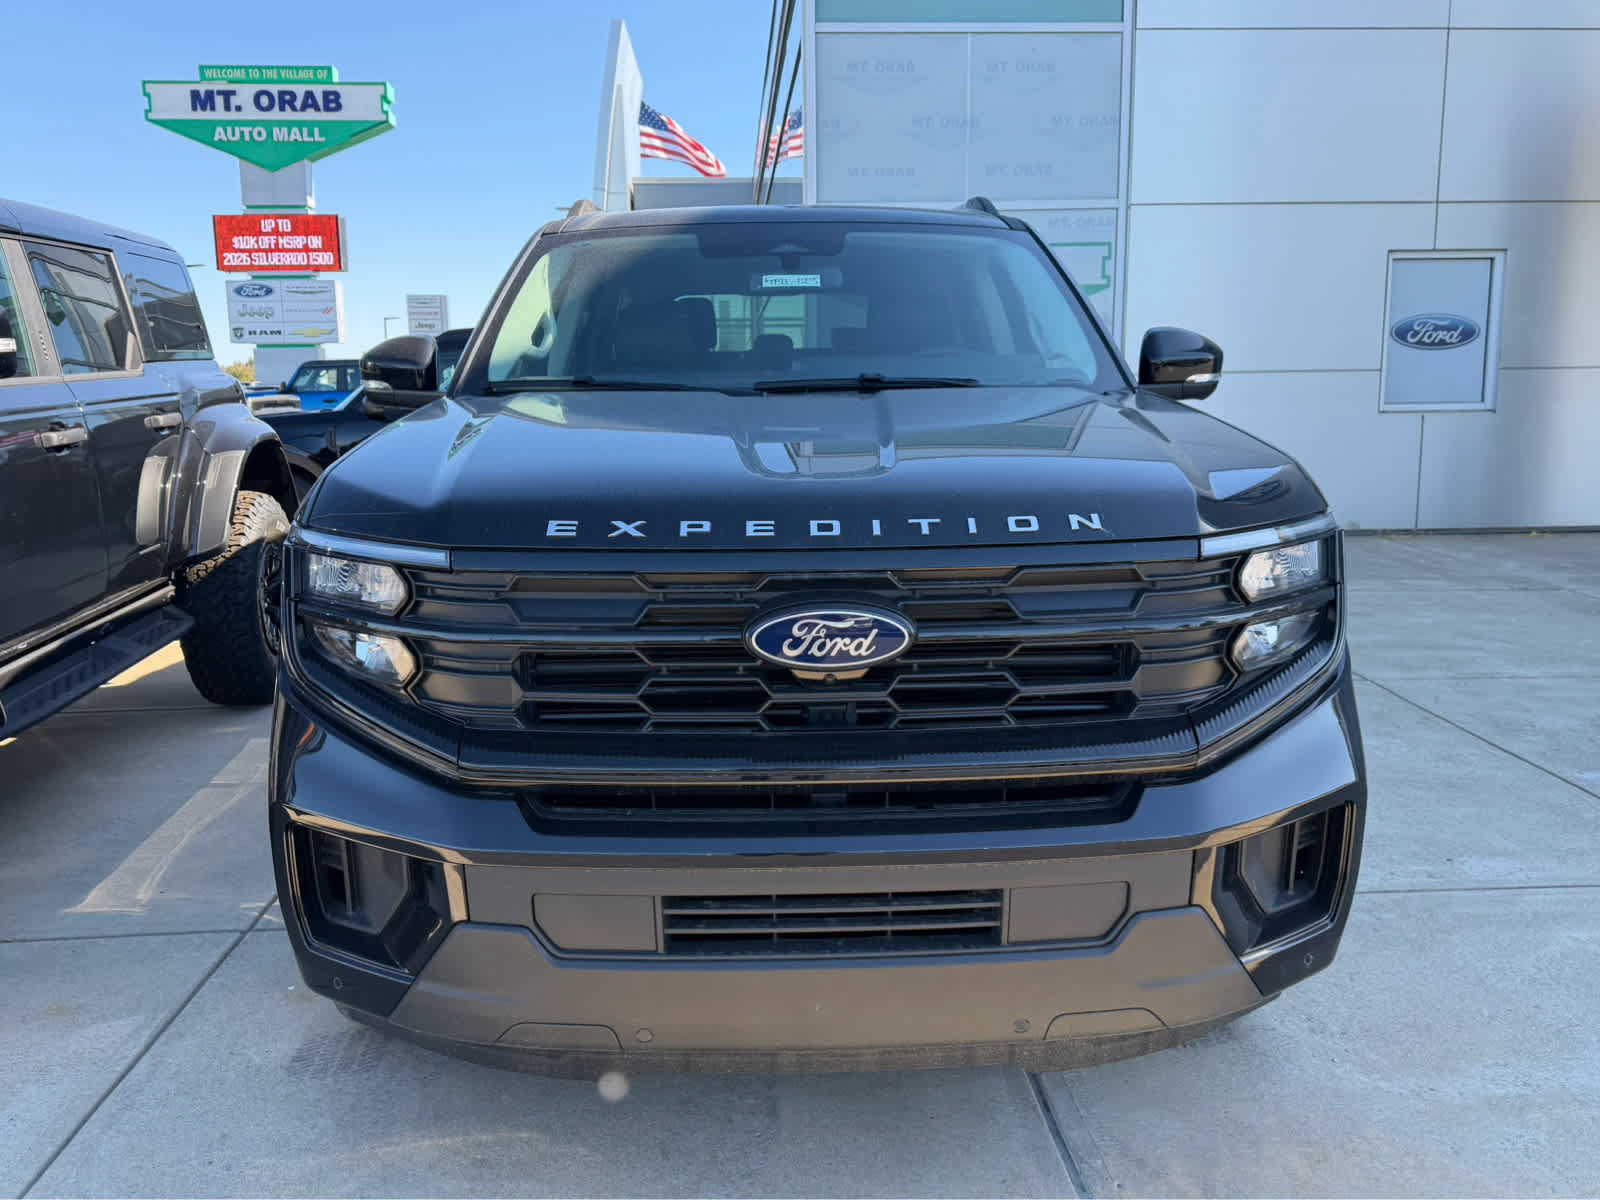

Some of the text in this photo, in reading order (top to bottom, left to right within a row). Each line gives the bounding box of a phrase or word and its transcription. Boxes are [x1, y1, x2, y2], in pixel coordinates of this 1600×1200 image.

[204, 68, 328, 80] WELCOME TO THE VILLAGE OF
[190, 89, 343, 112] MT. ORAB
[213, 126, 326, 142] AUTO MALL
[261, 219, 291, 232] UP TO
[232, 236, 322, 249] $10K OFF MSRP ON
[251, 252, 307, 265] SILVERADO
[308, 252, 334, 265] 1500
[240, 286, 268, 296] Ford
[237, 304, 274, 319] Jeep
[1407, 319, 1463, 343] Ford
[546, 513, 1104, 537] EXPEDITION
[782, 618, 879, 660] Ford
